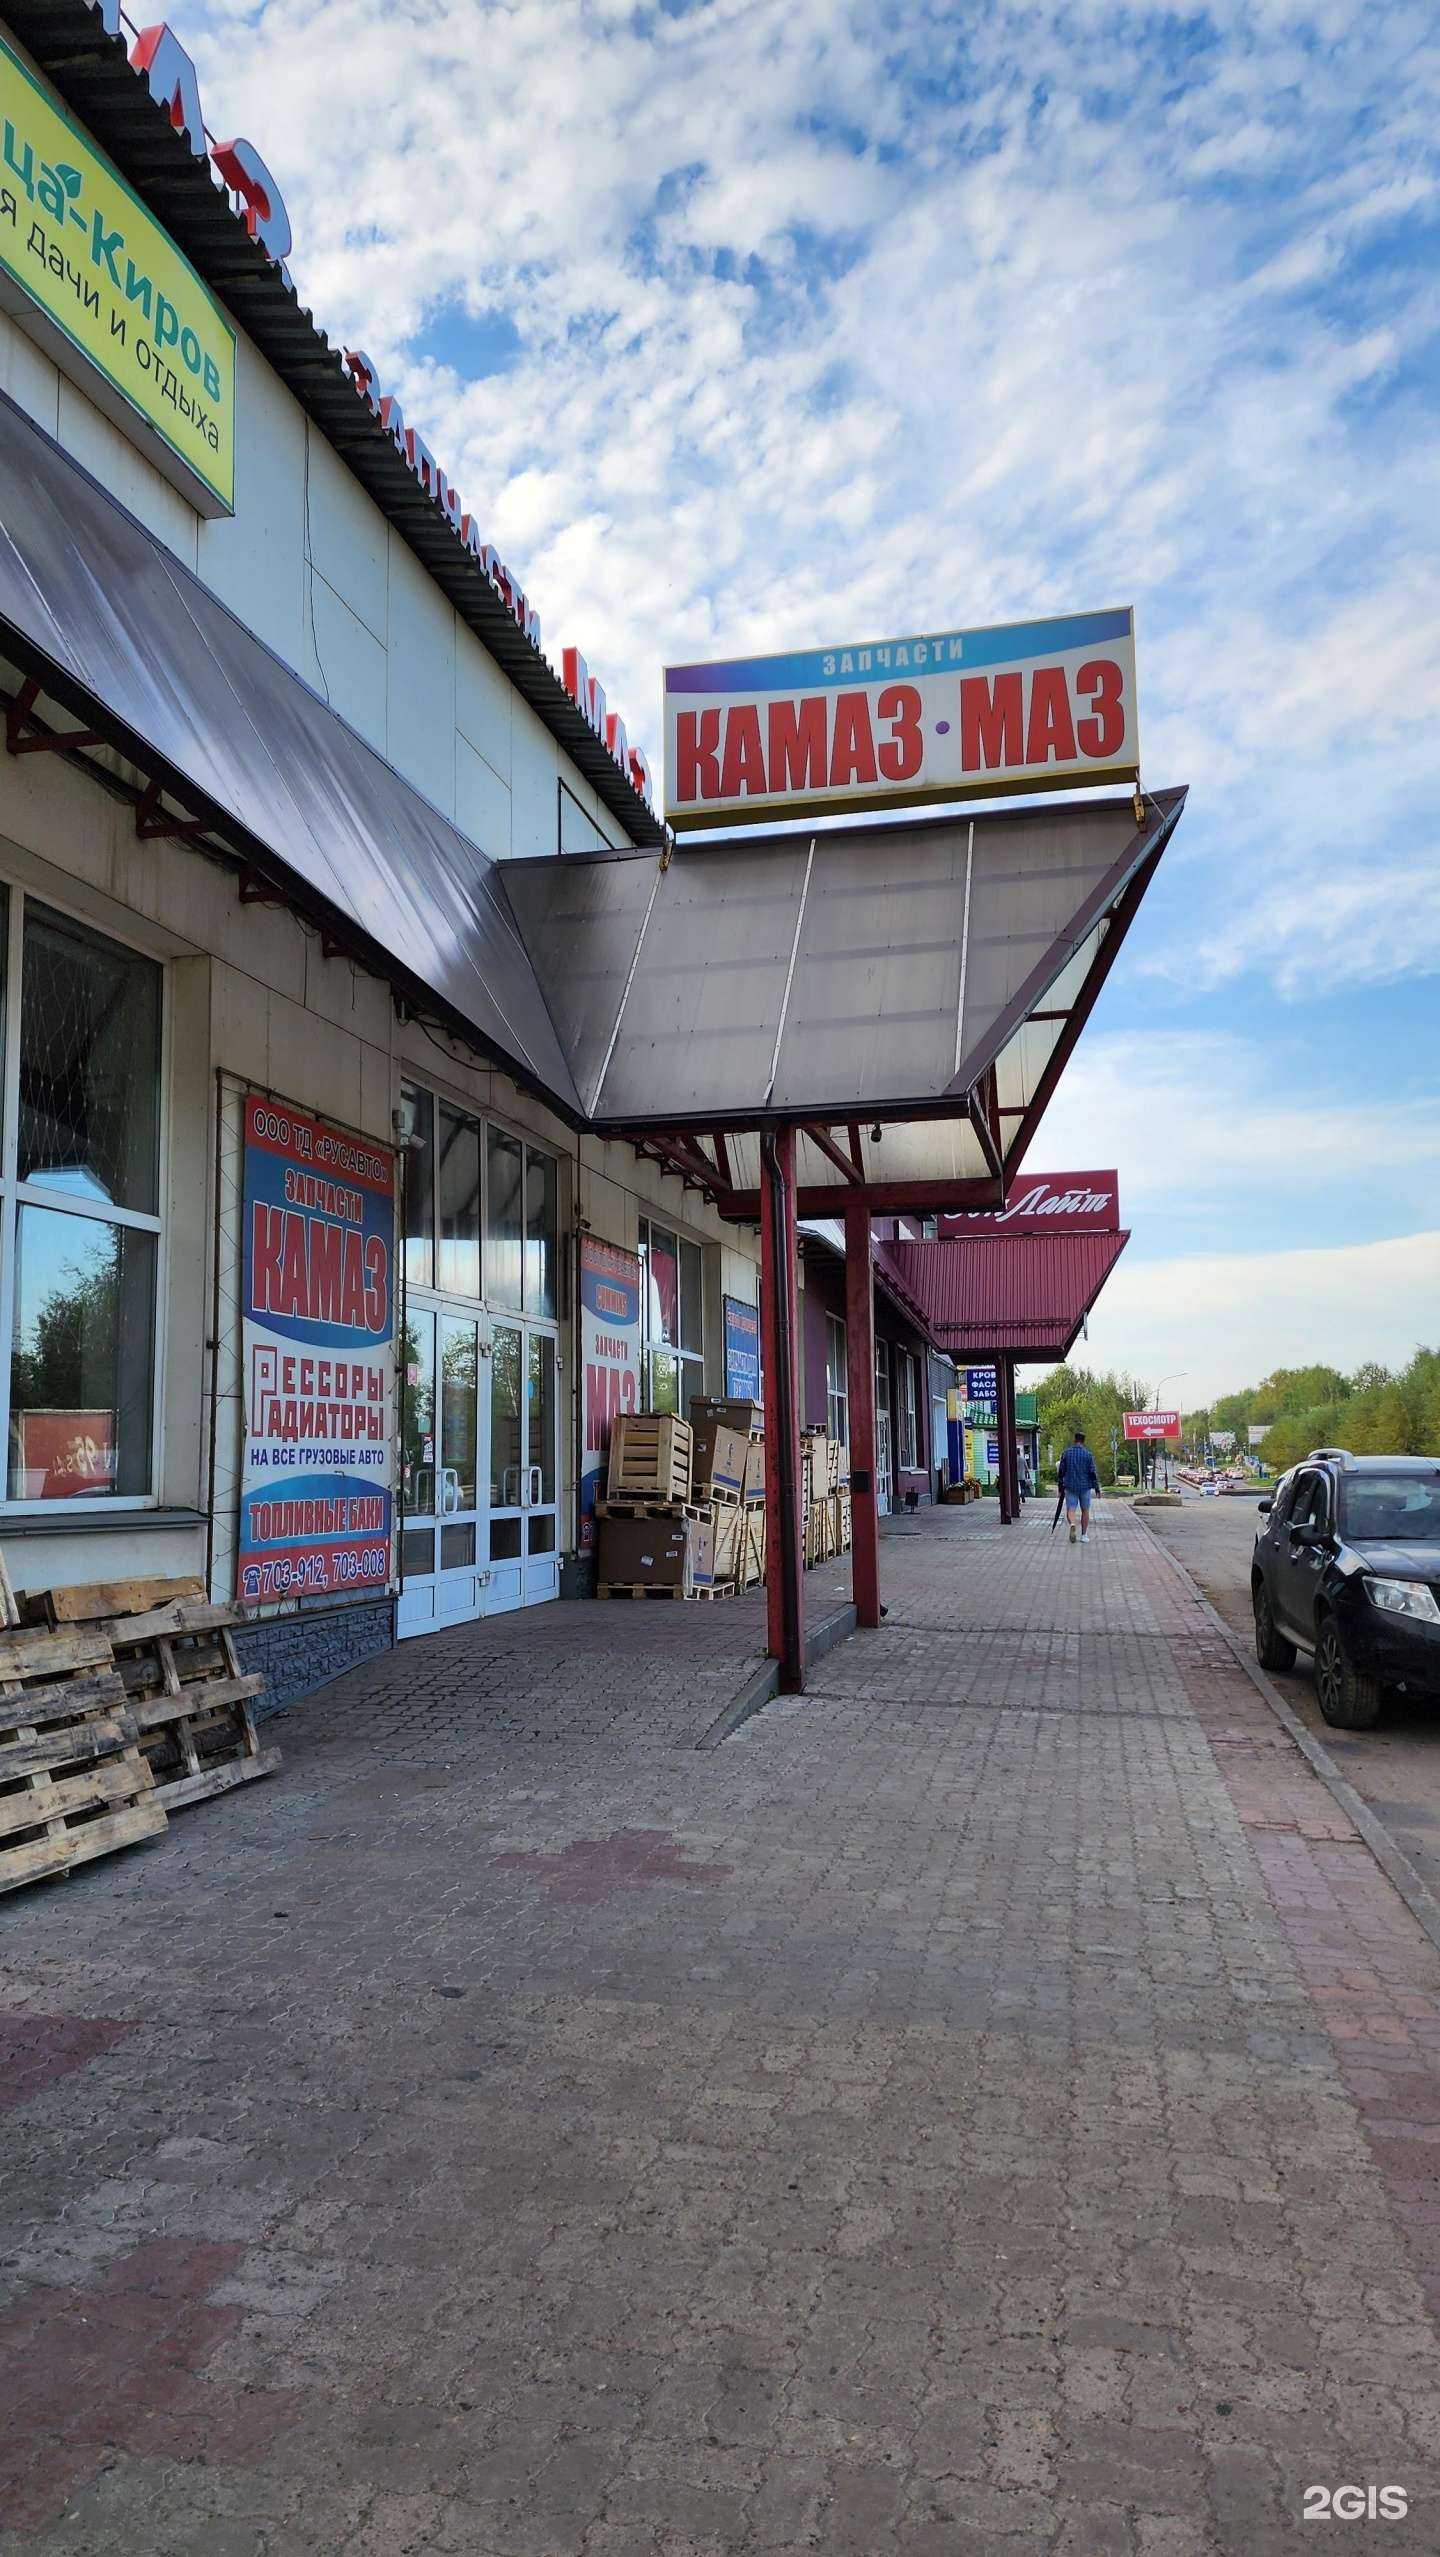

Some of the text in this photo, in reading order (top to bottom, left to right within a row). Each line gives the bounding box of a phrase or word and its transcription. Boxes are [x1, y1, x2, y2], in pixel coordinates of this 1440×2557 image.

[27, 222, 99, 319] дачи
[110, 308, 126, 346] и
[135, 337, 219, 453] отдыха
[823, 637, 965, 676] ЗАПЧАСТИ
[676, 659, 1125, 802] КАМАЗ МАЗ
[253, 1108, 388, 1184] ООО ТД «РУСАВТО»
[284, 1167, 364, 1225] ЗАПЧАСТИ
[252, 1200, 388, 1334] КАМАЗ
[595, 1334, 628, 1361] ЗАПЧАСТИ
[1128, 1414, 1177, 1426] ТЕХОСМОТР
[250, 1448, 384, 1466] НА ВСЕ ГРУЗОВЫЕ АВТО
[249, 1496, 384, 1542] ТОПЛИВНЫЕ БАКИ
[262, 1547, 386, 1593] 703-912, 703-008
